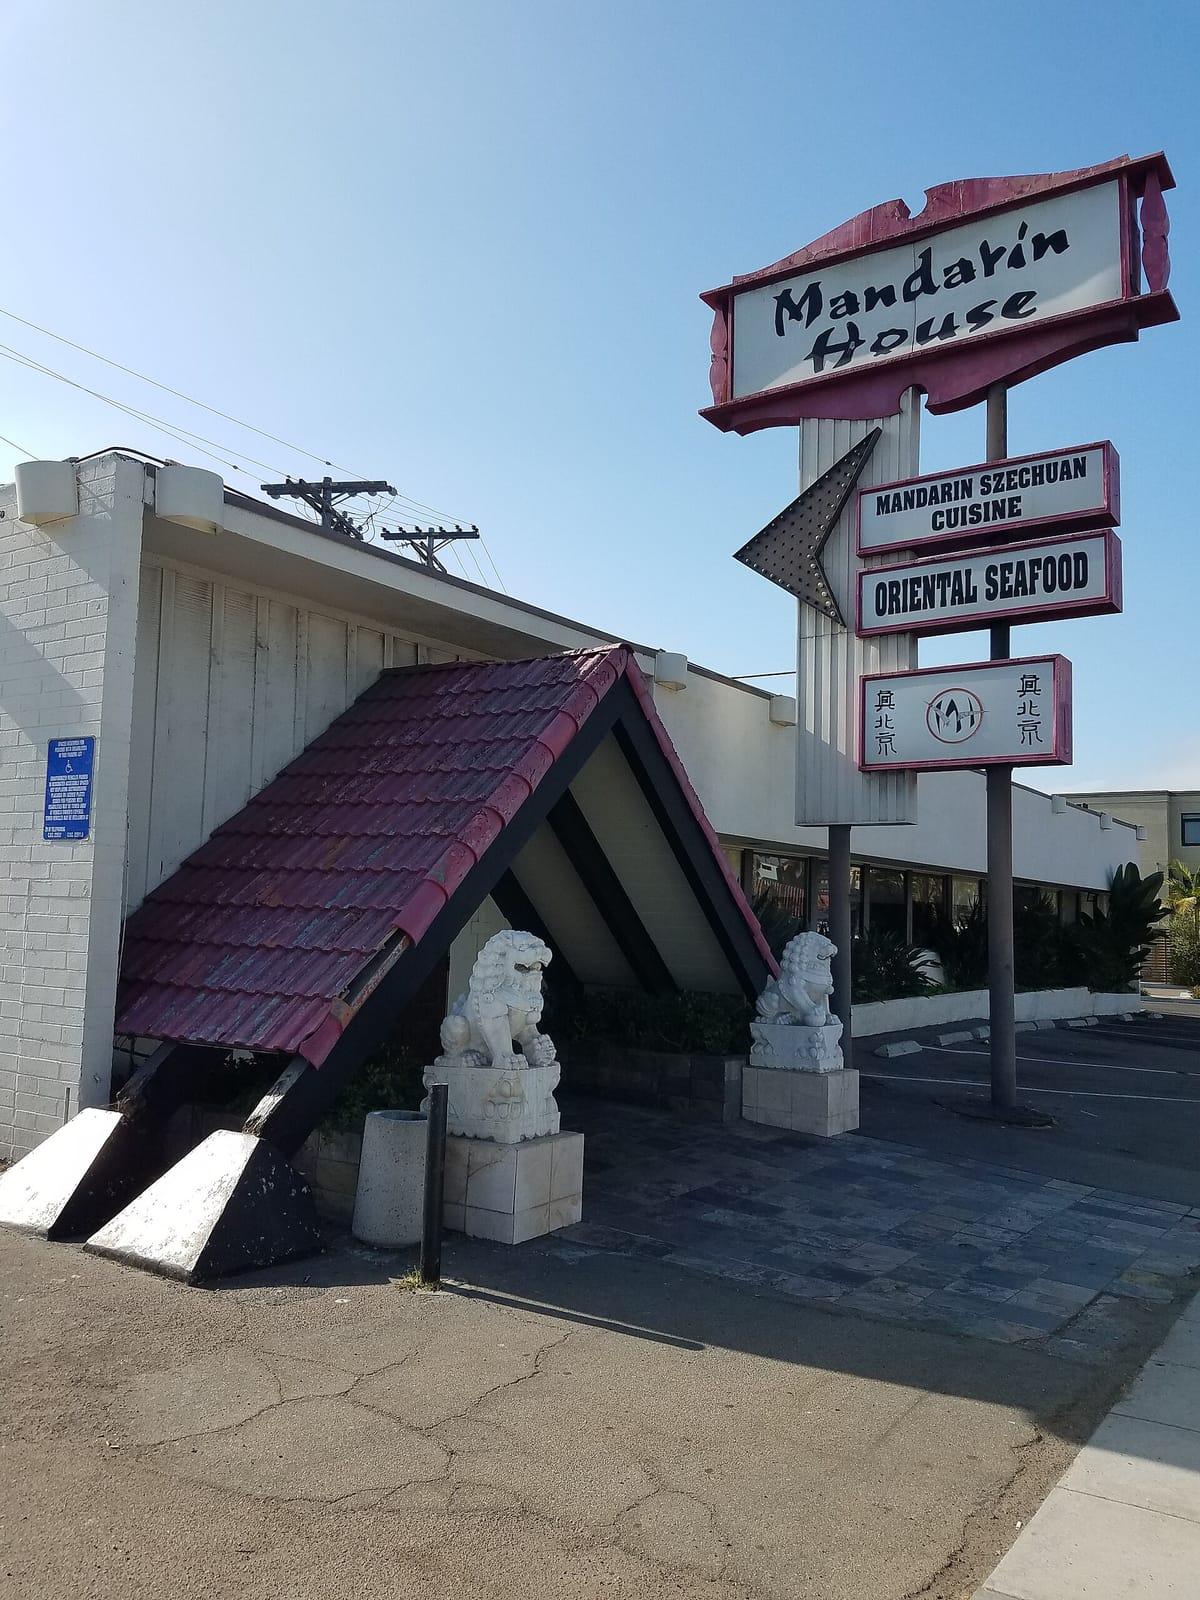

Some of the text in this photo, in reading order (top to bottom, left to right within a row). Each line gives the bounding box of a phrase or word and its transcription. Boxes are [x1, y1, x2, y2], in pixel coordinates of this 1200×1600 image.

[773, 222, 1069, 336] Mandarin
[803, 290, 1037, 373] House
[876, 456, 1087, 515] MANDARIN SZECHUAN
[931, 496, 1022, 531] CUISINE
[875, 552, 1088, 617] ORIENTAL SEAFOOD
